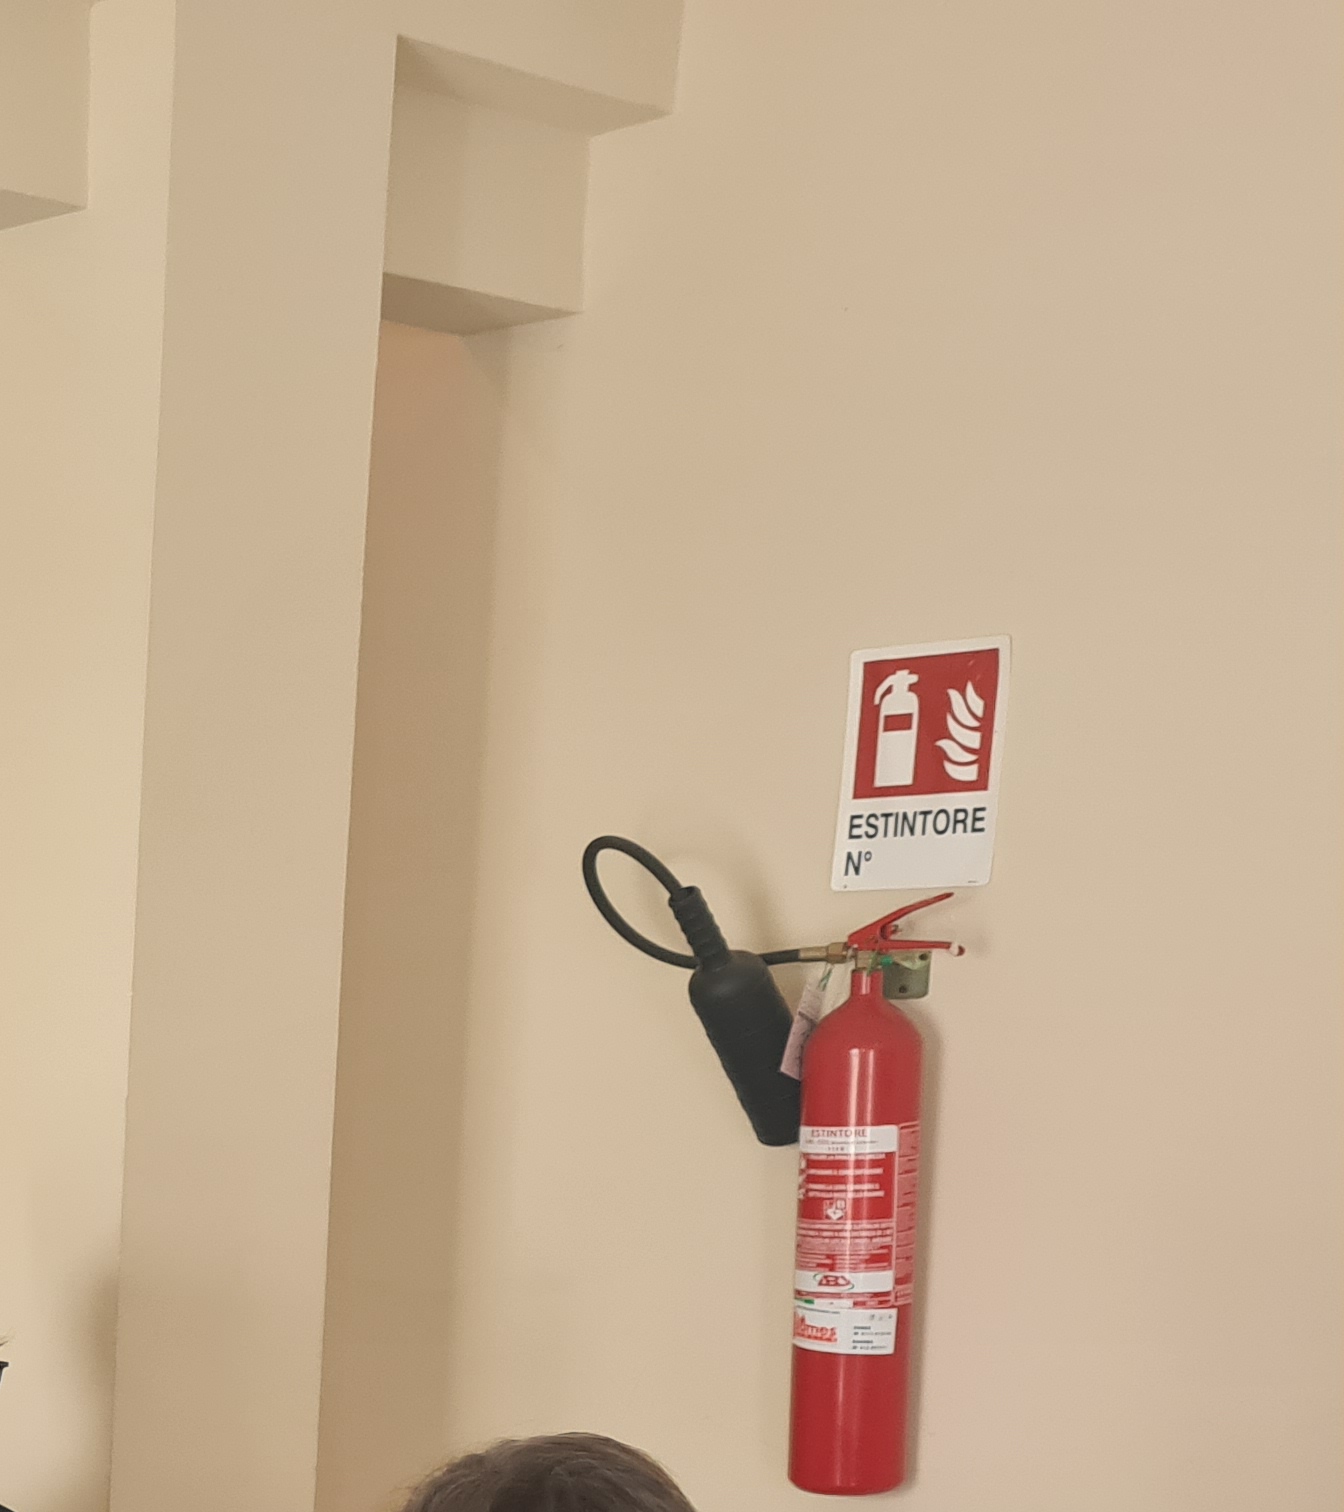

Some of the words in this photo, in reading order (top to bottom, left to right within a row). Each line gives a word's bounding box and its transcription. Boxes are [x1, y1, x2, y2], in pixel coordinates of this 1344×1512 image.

[848, 807, 987, 840] ESTINTORE
[843, 850, 873, 877] N°
[811, 1128, 868, 1138] ESTINTORE
